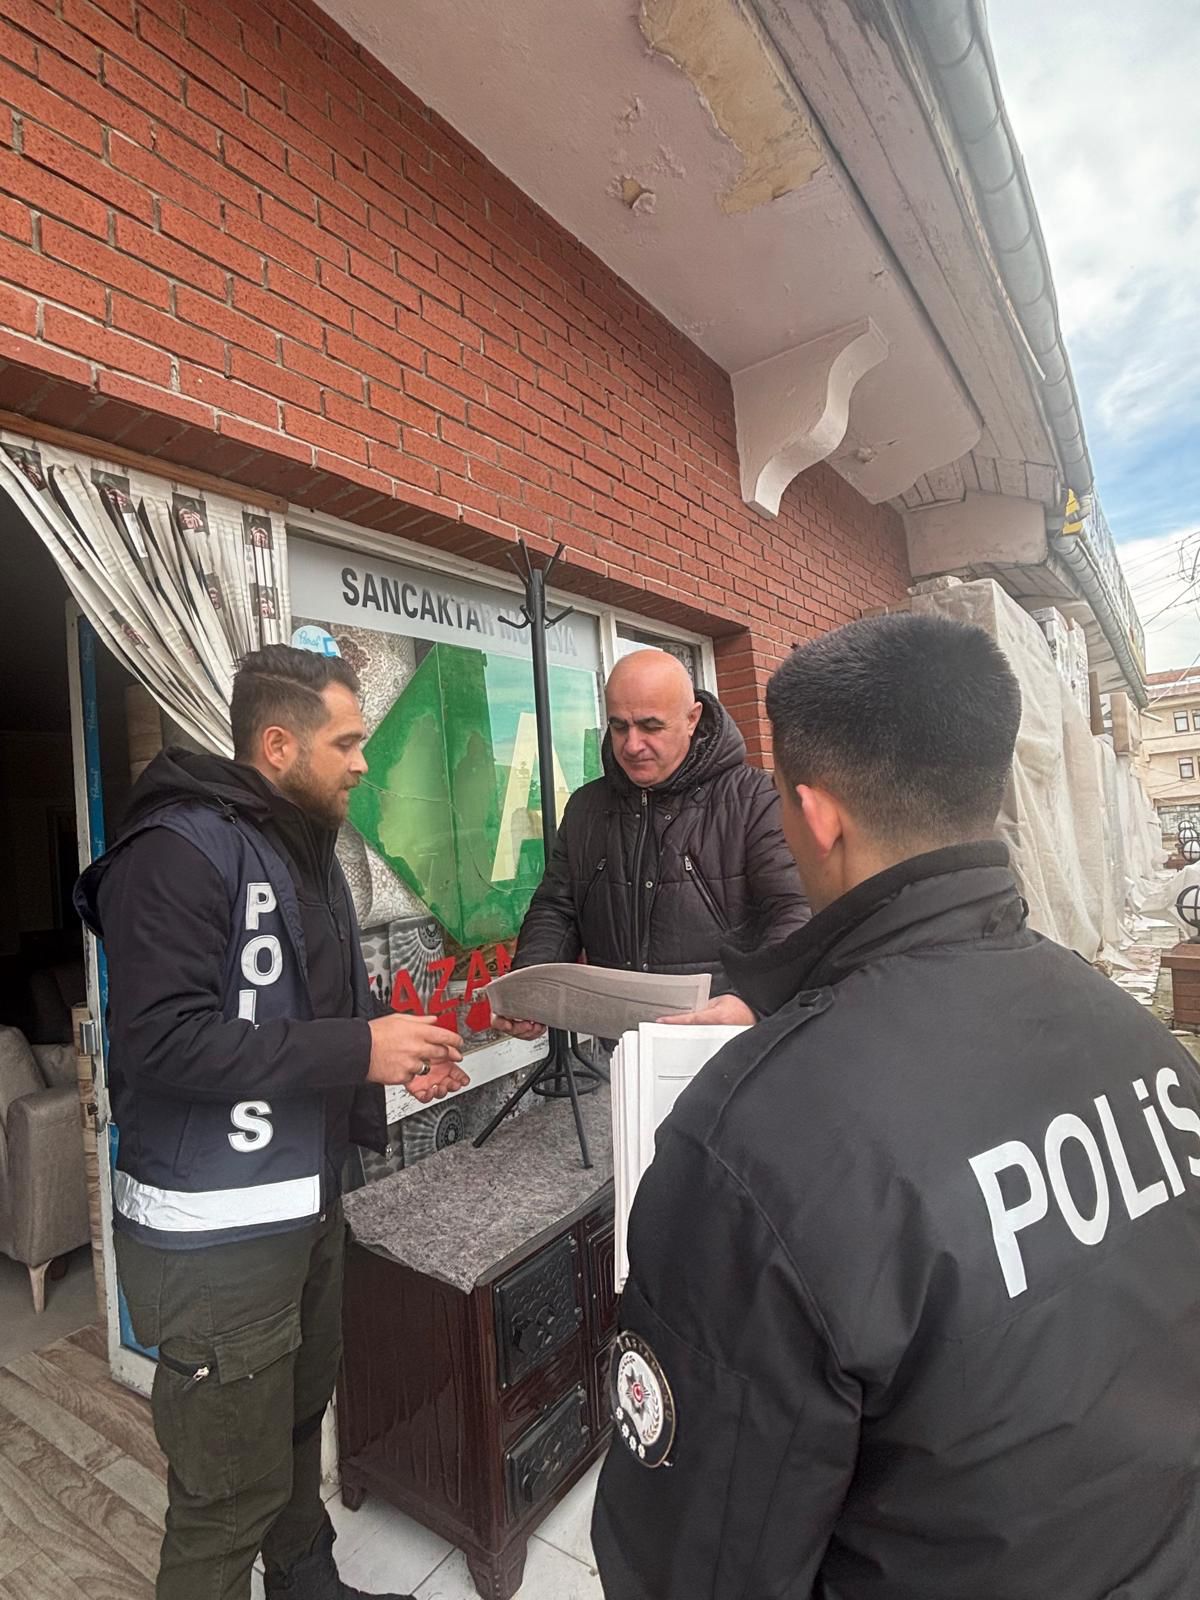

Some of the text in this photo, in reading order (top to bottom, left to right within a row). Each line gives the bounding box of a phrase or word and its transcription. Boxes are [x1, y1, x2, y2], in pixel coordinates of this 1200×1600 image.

[341, 567, 578, 657] SANCAKTAR MOLYA
[227, 882, 284, 1153] POS
